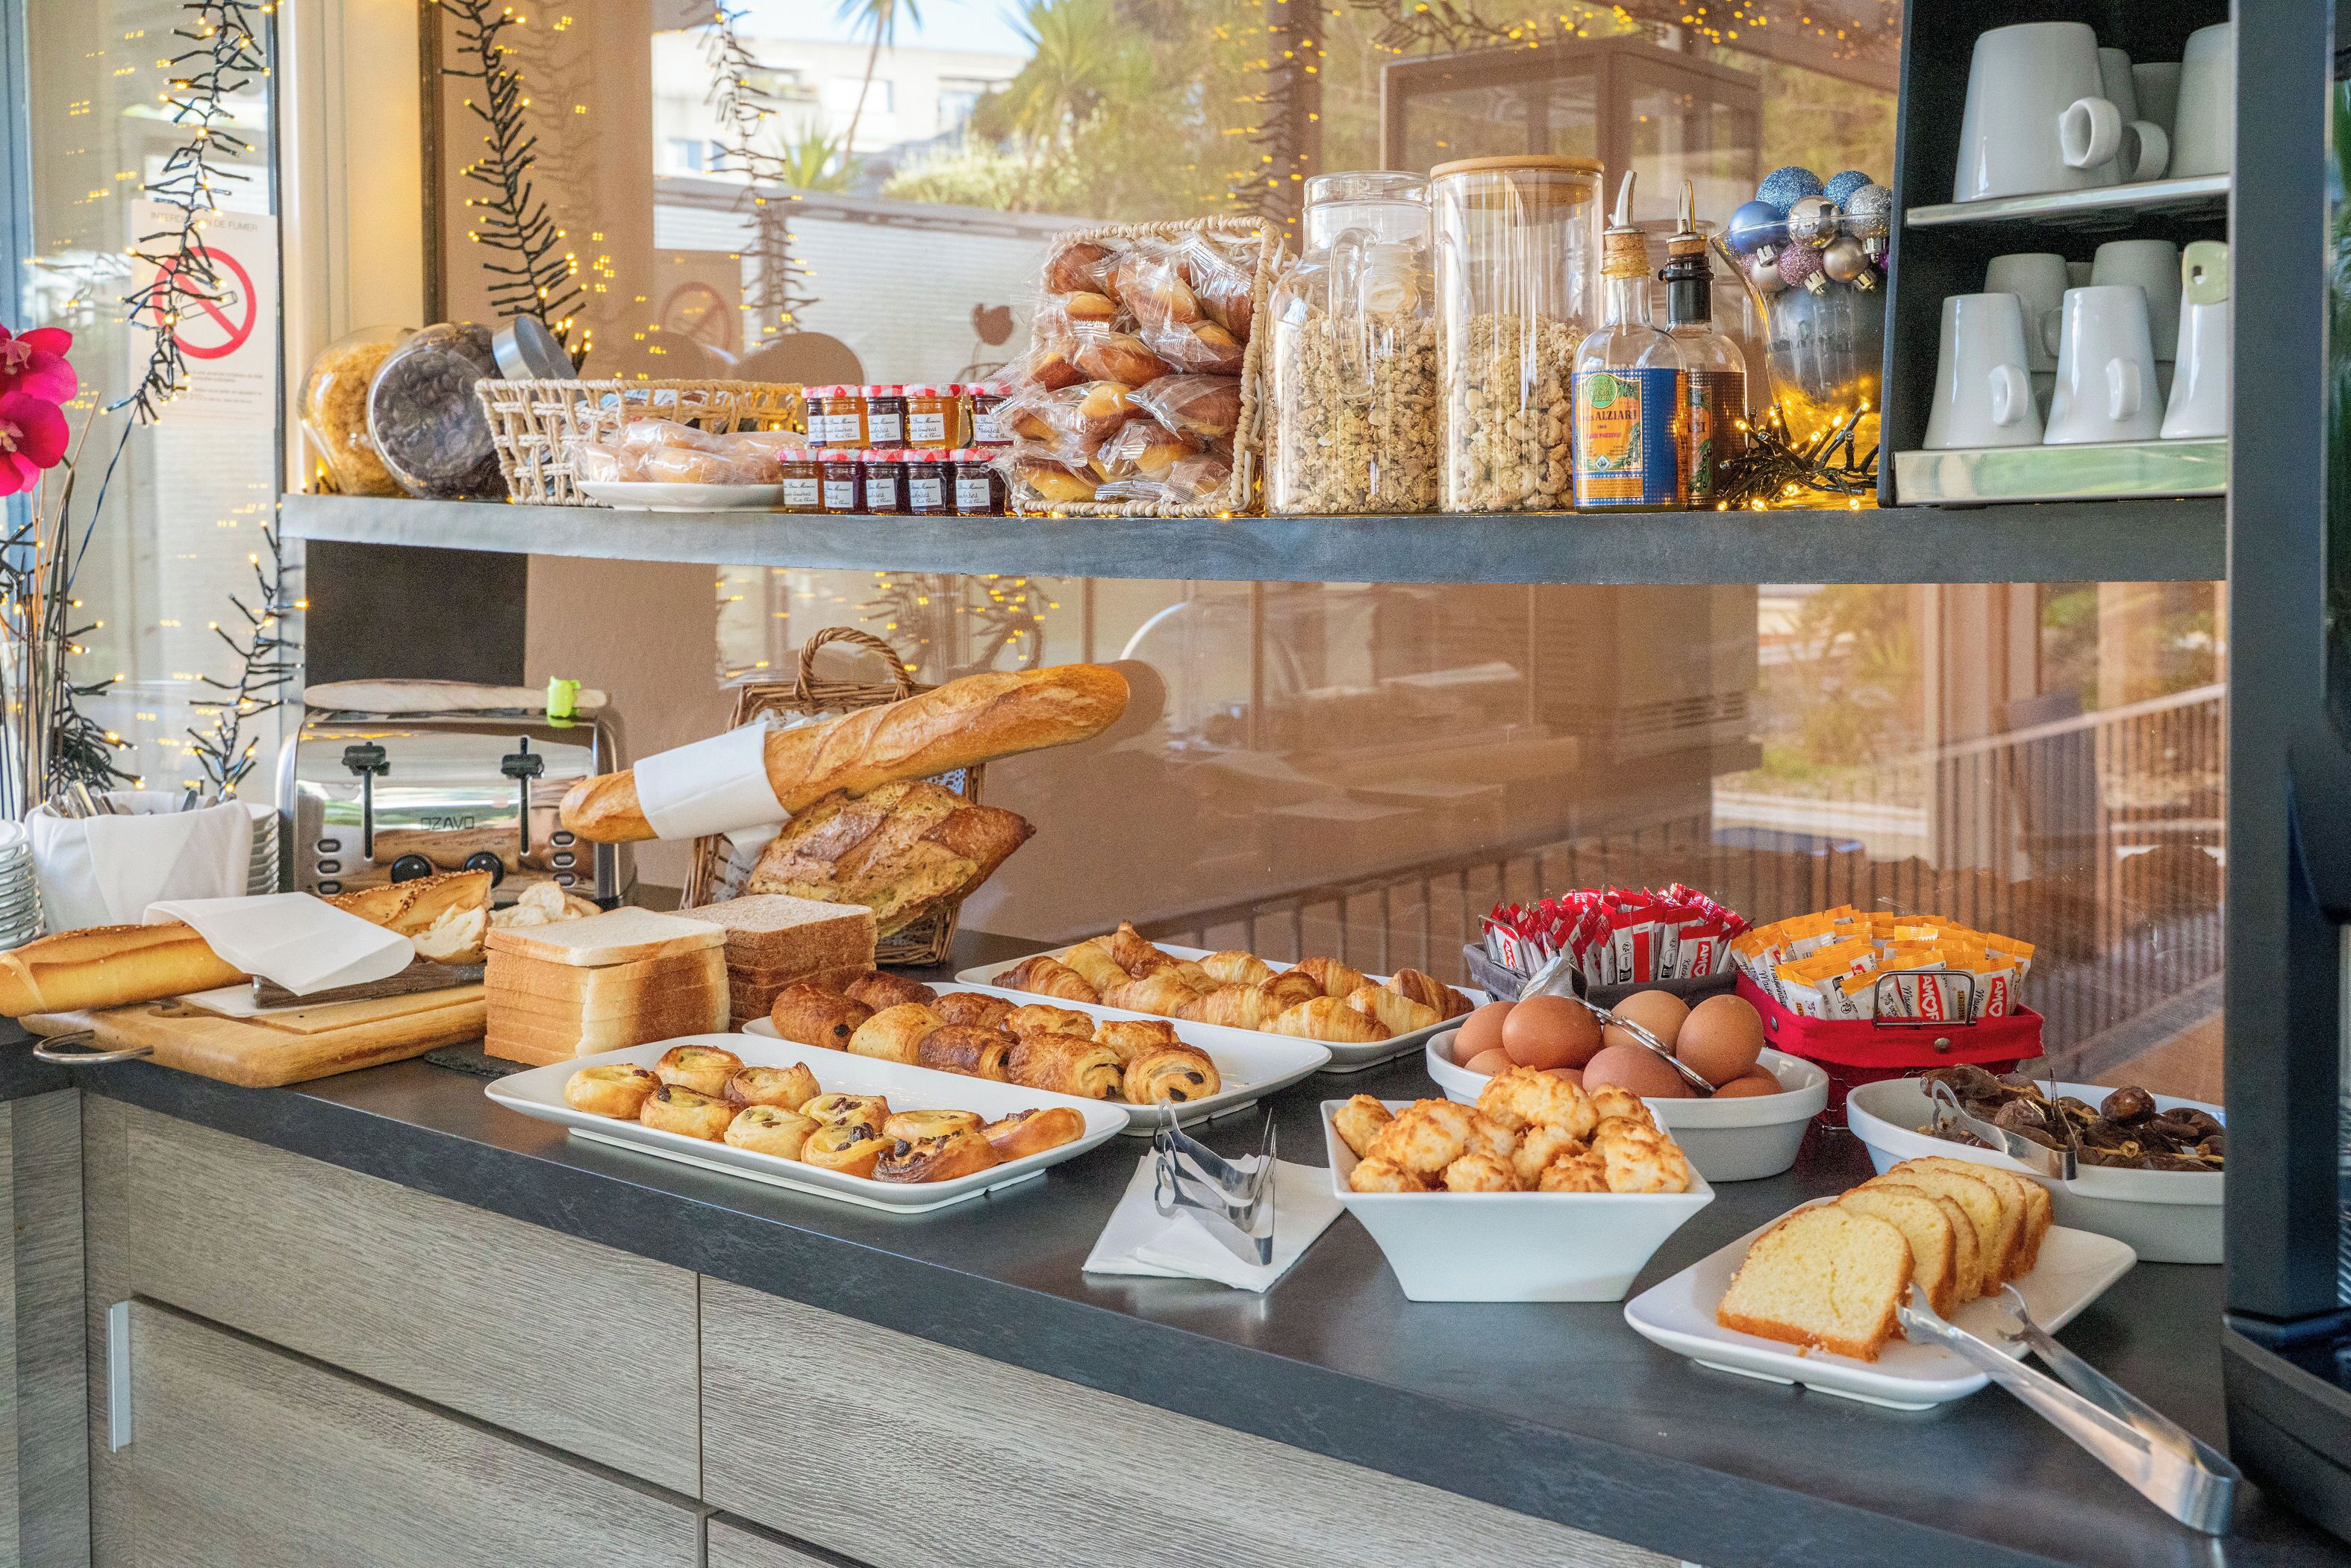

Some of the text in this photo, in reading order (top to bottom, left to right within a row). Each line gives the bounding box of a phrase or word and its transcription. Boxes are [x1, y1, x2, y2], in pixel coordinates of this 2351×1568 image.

[151, 212, 257, 233] INTERDN DE FUMER
[1596, 410, 1637, 421] ALZIARI
[1680, 958, 1691, 979] Ketch
[1693, 944, 1709, 977] AMO
[1922, 974, 1940, 1021] AMOR
[1988, 980, 2004, 1017] AMO
